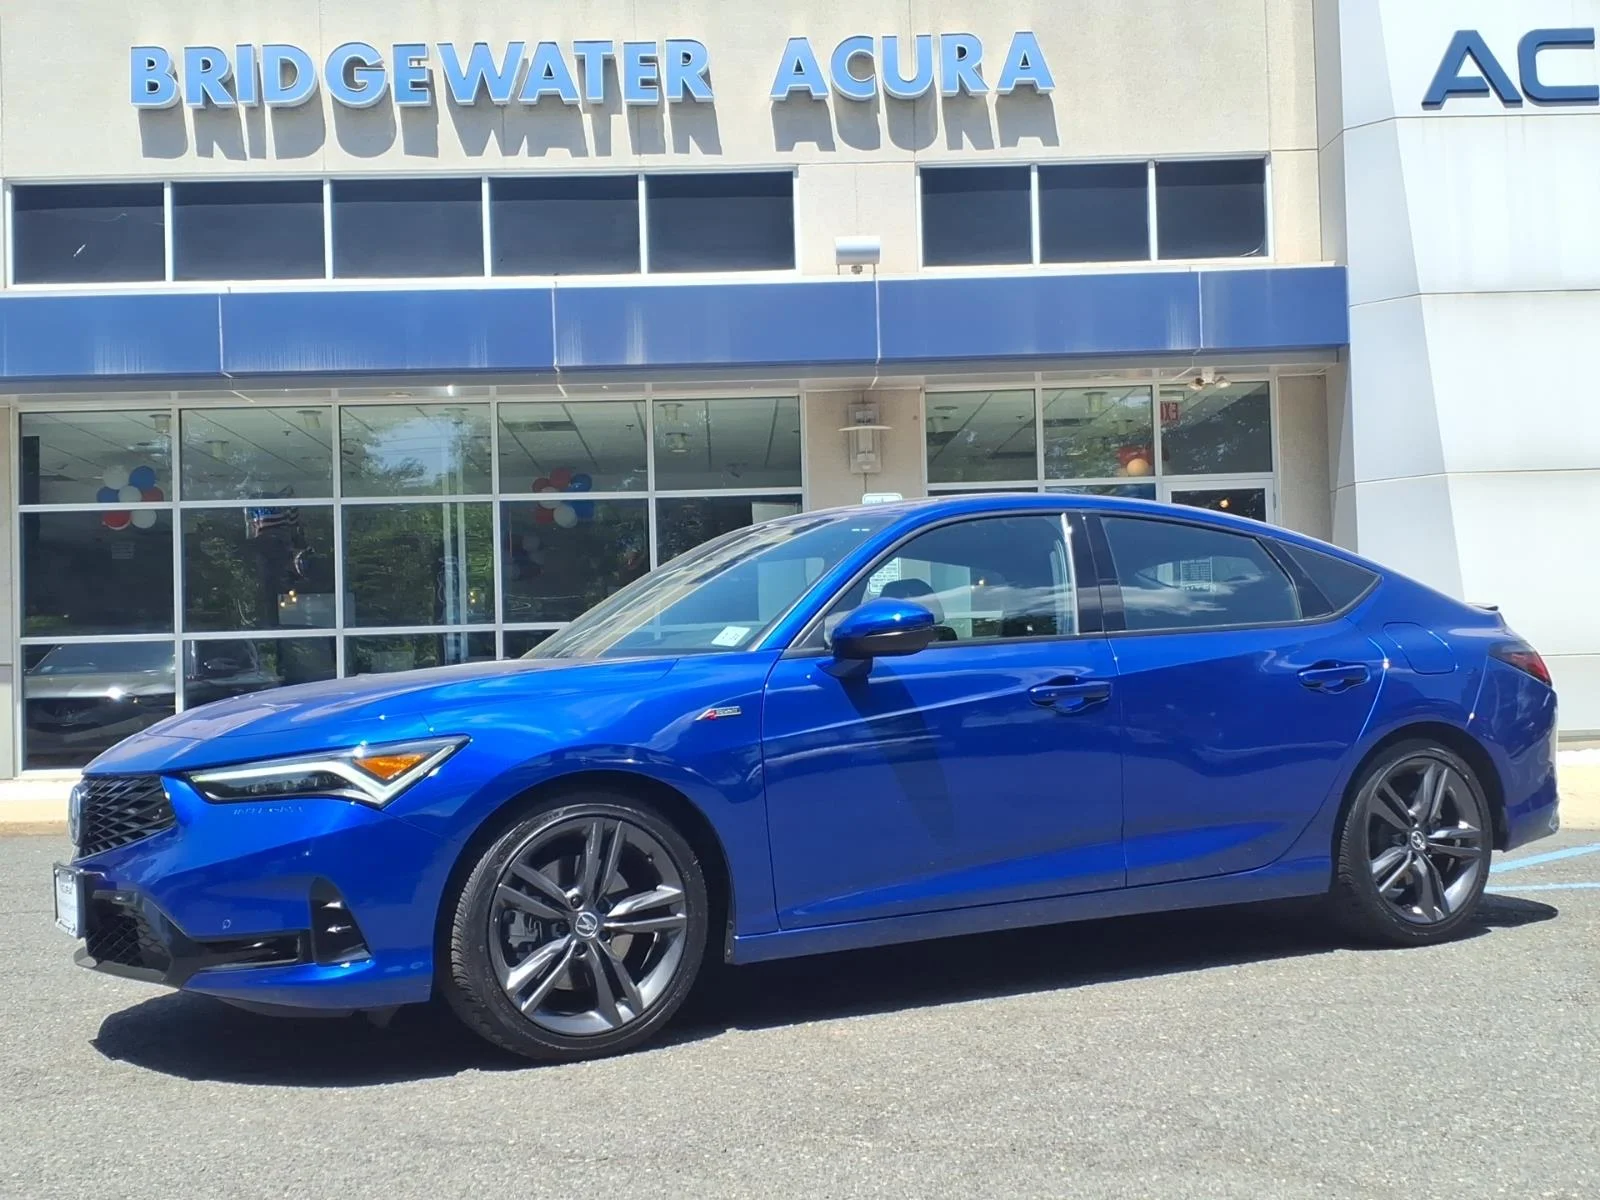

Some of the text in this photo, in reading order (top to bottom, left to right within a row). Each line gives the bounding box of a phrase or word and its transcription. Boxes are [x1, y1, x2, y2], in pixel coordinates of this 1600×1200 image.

[130, 30, 1056, 109] BRIDGEWATER ACURA
[1421, 28, 1600, 108] AC
